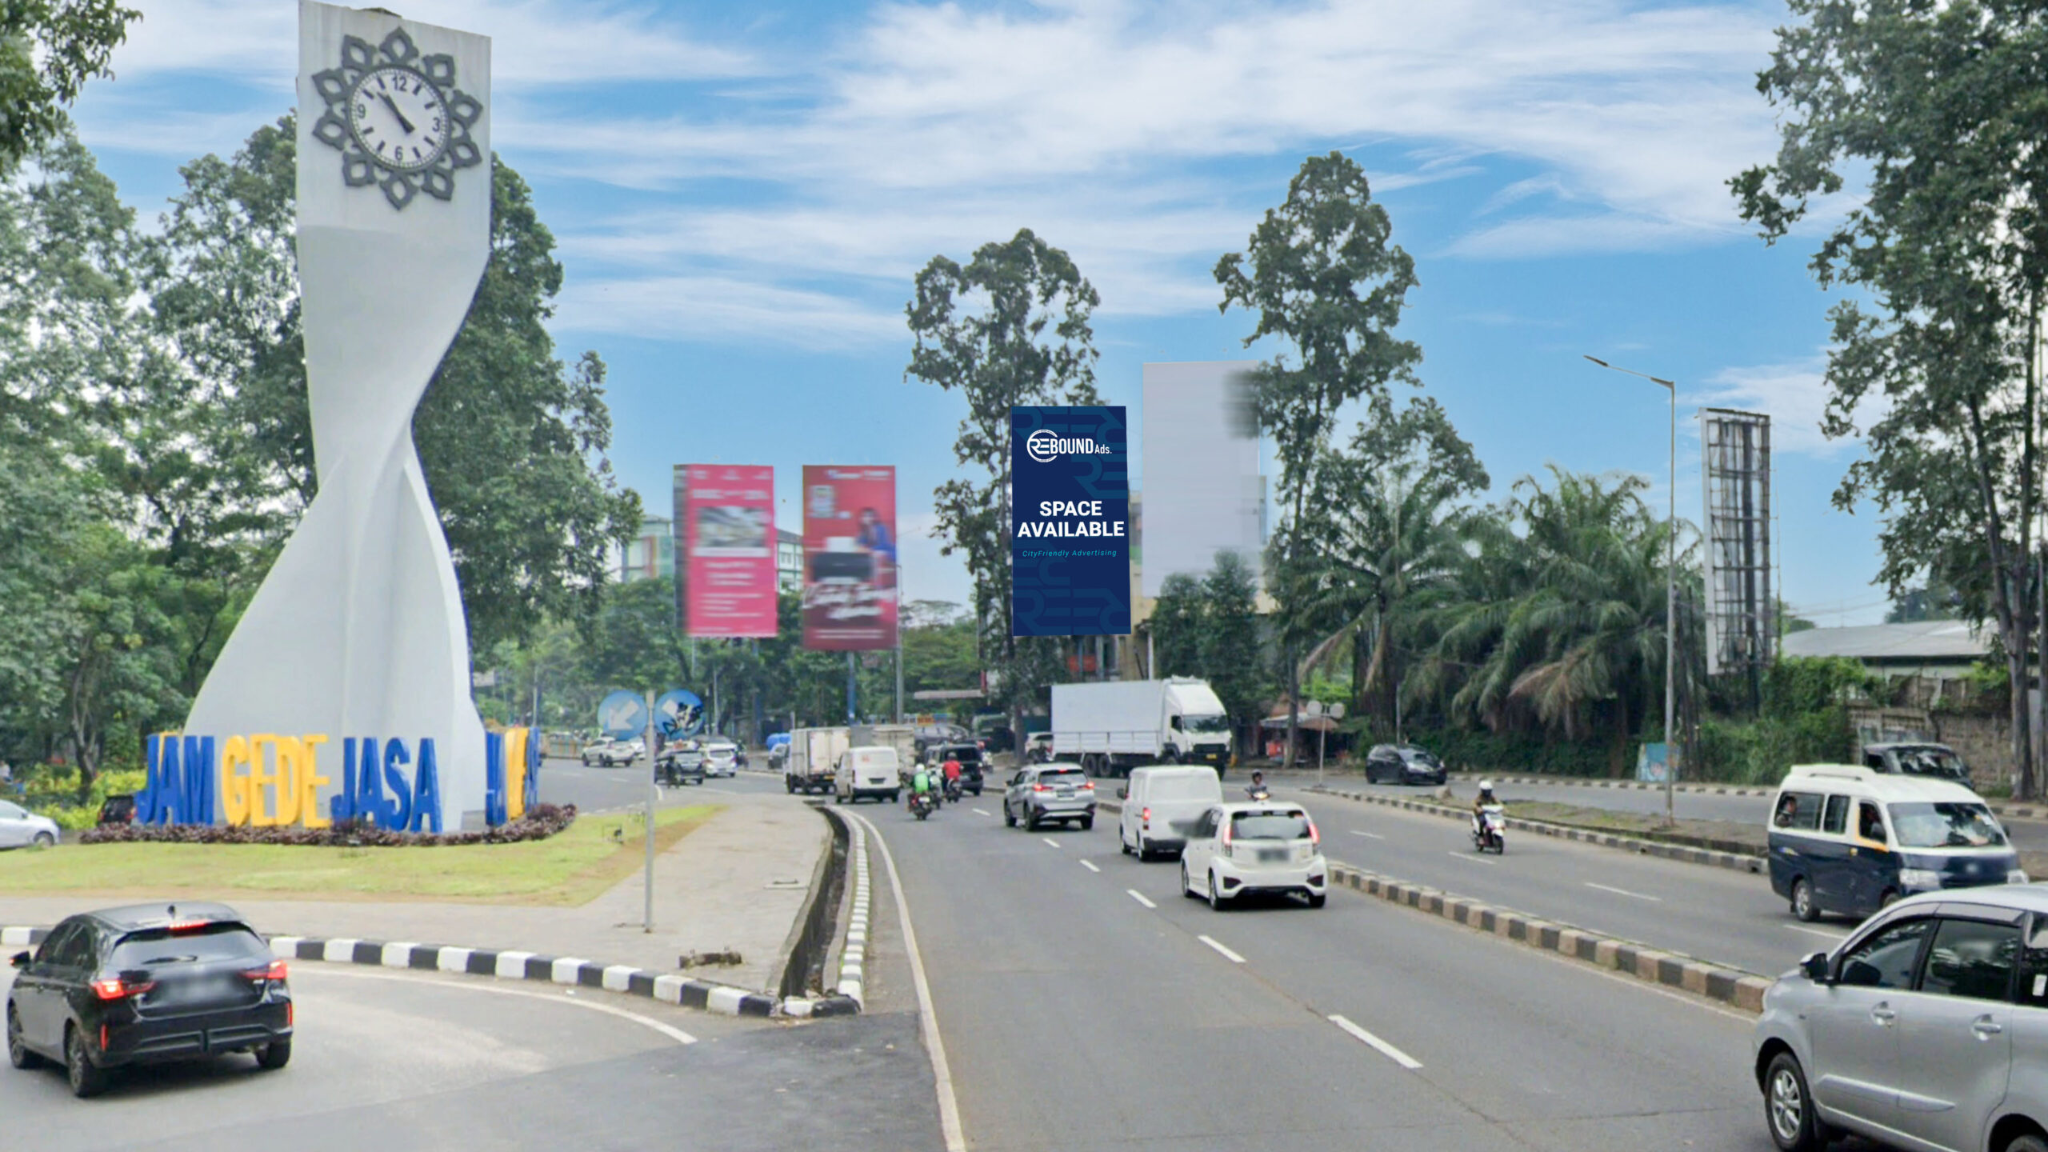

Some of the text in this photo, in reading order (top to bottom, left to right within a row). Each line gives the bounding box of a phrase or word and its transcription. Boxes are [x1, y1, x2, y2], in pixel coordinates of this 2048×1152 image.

[392, 75, 407, 92] 12
[357, 103, 366, 119] 9
[432, 117, 440, 132] 3
[394, 146, 403, 161] 6
[1039, 500, 1102, 517] SPACE
[1017, 521, 1125, 538] AVAILABLE
[1022, 550, 1117, 558] CityFriendly Advertising
[133, 735, 215, 826] JAM
[222, 733, 331, 828] GEDE
[331, 737, 443, 834] JASA
